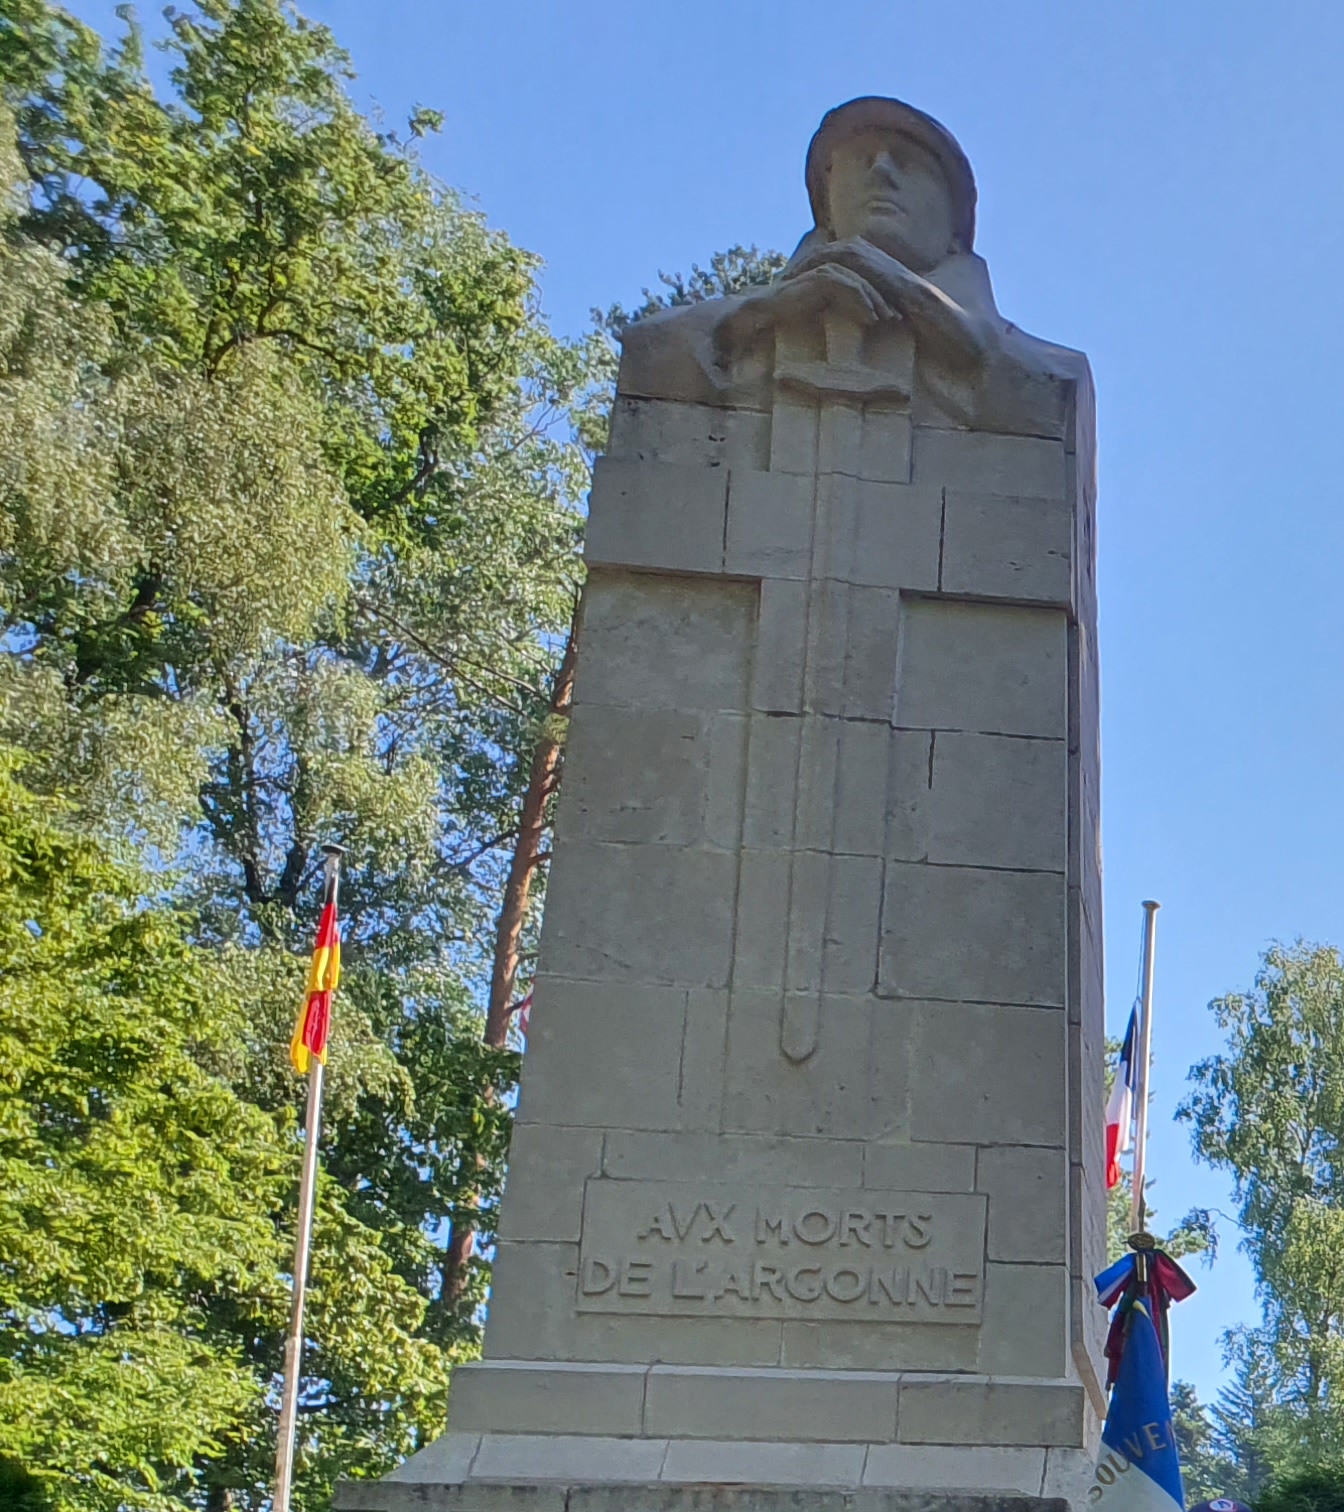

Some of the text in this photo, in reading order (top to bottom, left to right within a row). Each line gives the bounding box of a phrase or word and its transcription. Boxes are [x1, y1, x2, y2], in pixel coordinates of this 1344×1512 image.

[755, 1207, 933, 1249] MORTS
[581, 1261, 978, 1307] DE L'ARGONNE
